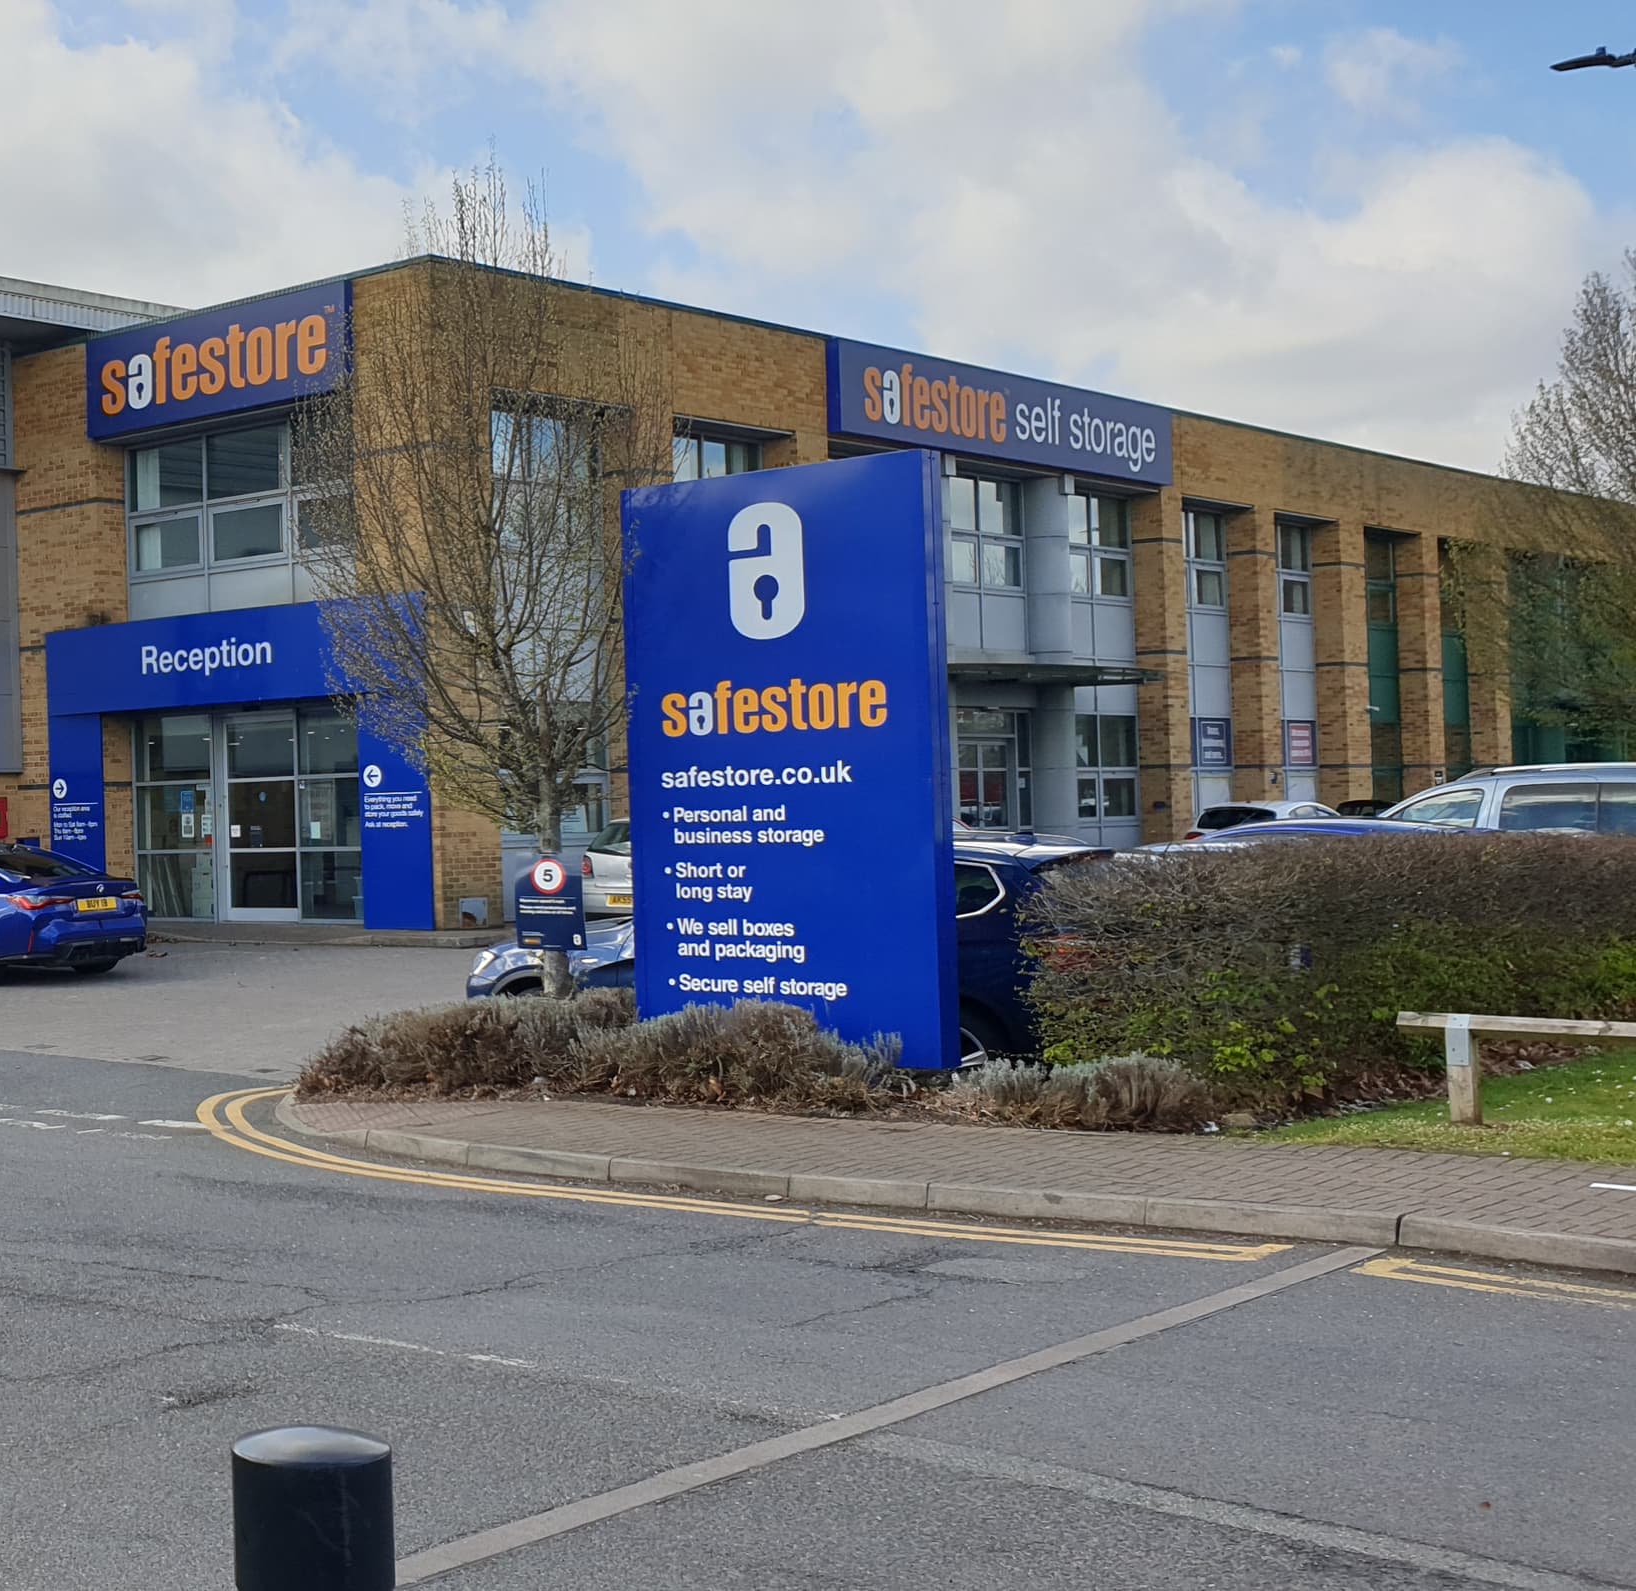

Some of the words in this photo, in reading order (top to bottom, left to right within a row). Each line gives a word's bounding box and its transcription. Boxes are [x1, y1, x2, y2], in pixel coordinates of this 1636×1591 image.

[100, 314, 328, 416] safestore
[863, 363, 1007, 443] safestore
[1015, 397, 1061, 445] self
[1069, 407, 1156, 473] storage
[141, 637, 272, 677] Reception
[661, 678, 888, 738] safestore
[661, 759, 852, 789] safestore.co.uk
[673, 805, 748, 824] Personal
[752, 804, 786, 822] and
[673, 827, 753, 845] business
[757, 827, 825, 847] storage
[542, 868, 554, 883] 5
[675, 862, 723, 879] Short
[727, 864, 746, 879] or
[675, 883, 713, 903] long
[717, 883, 753, 903] stay
[677, 917, 704, 936] We
[708, 918, 738, 936] sell
[742, 919, 795, 938] boxes
[677, 939, 710, 957] and
[715, 940, 806, 964] packaging
[678, 973, 739, 994] Secure
[743, 976, 775, 995] self
[779, 978, 848, 1001] storage
